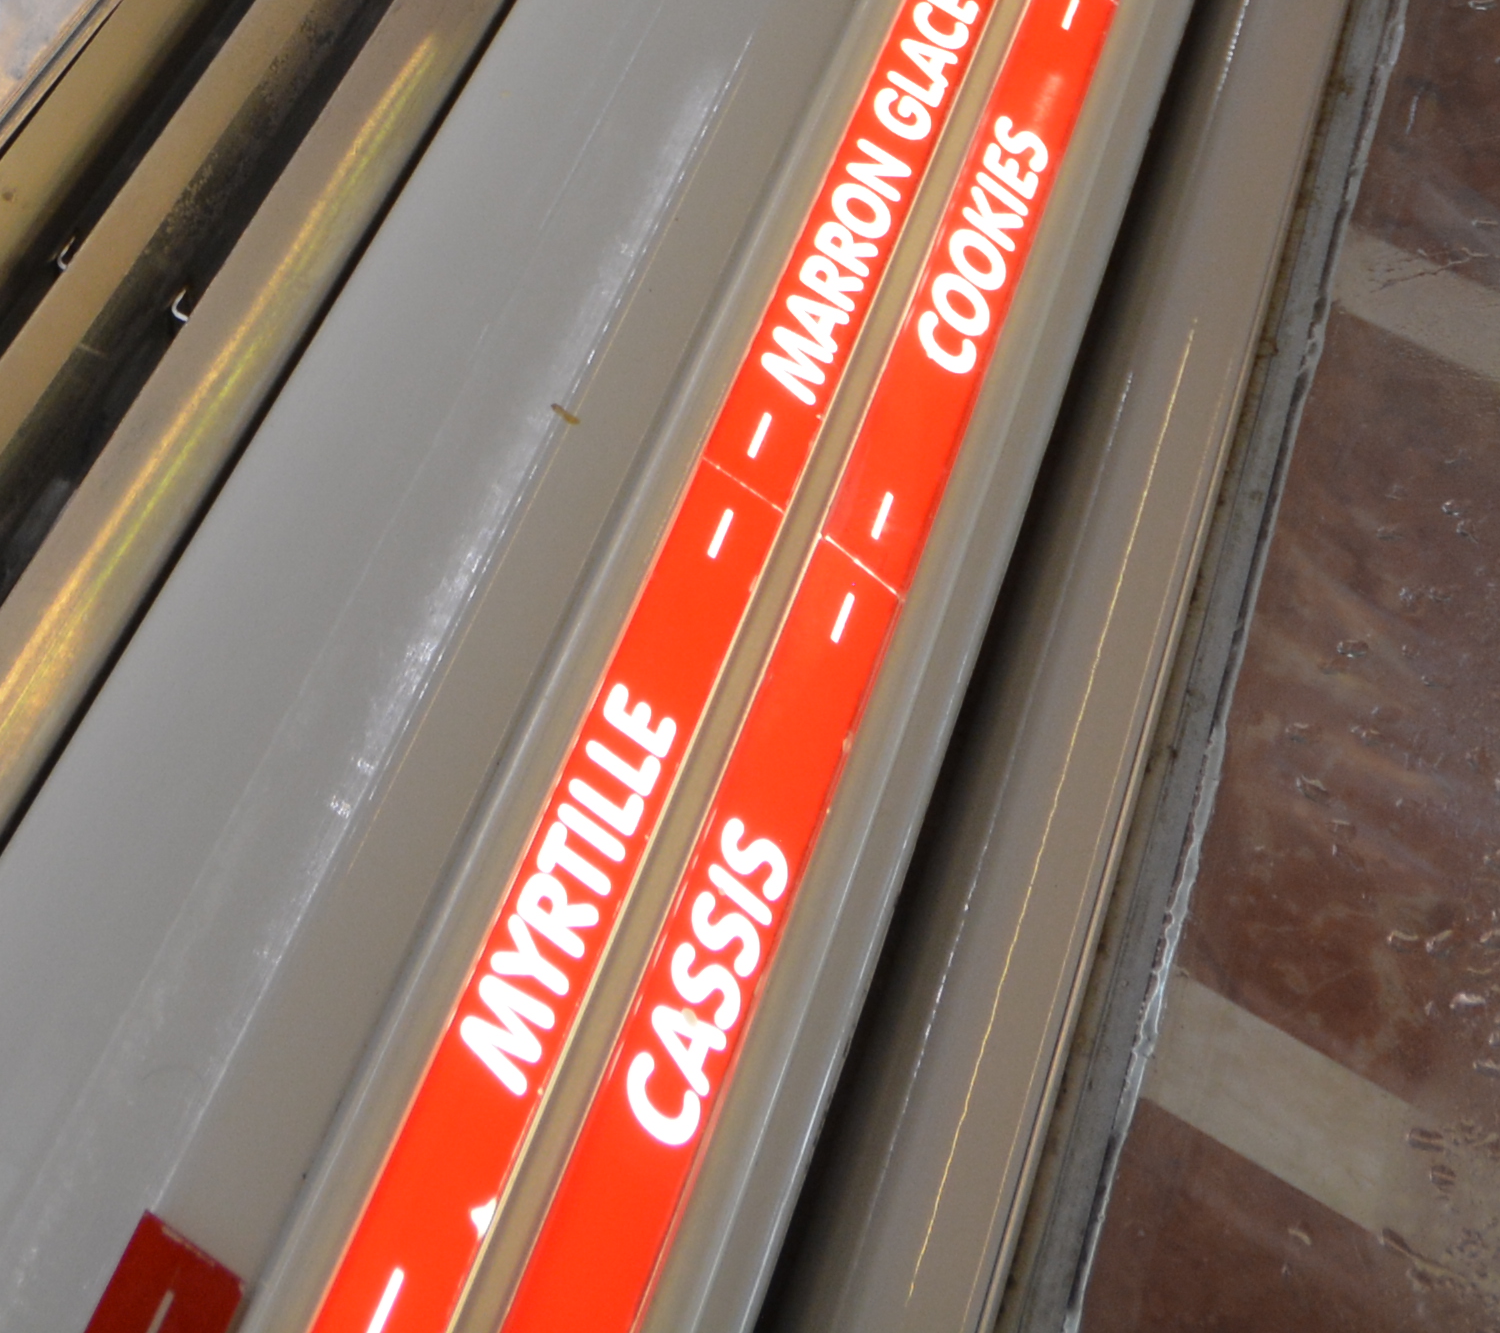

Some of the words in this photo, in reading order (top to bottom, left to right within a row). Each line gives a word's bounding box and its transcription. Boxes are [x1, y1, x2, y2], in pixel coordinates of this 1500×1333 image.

[761, 139, 912, 405] MARRON
[918, 116, 1049, 374] COOKIES
[459, 684, 677, 1097] MYRTILLE
[626, 817, 789, 1146] CASSIS
